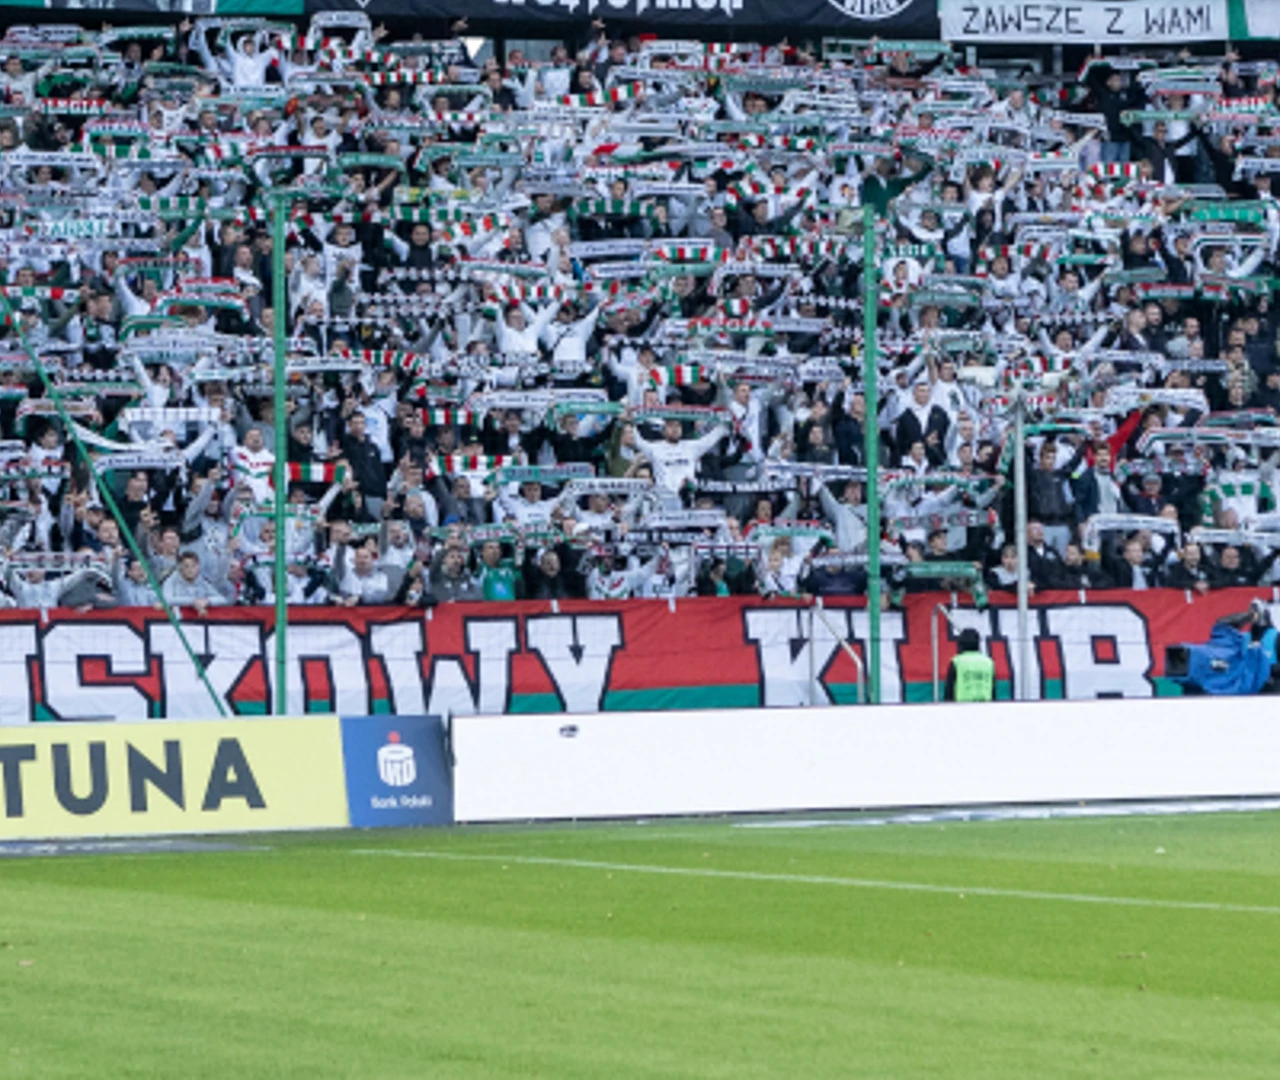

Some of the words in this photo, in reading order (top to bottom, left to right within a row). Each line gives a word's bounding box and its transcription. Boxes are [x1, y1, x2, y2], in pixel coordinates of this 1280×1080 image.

[962, 6, 1085, 35] ZAWSZE
[1105, 6, 1126, 35] Z
[1144, 5, 1212, 35] WAMI
